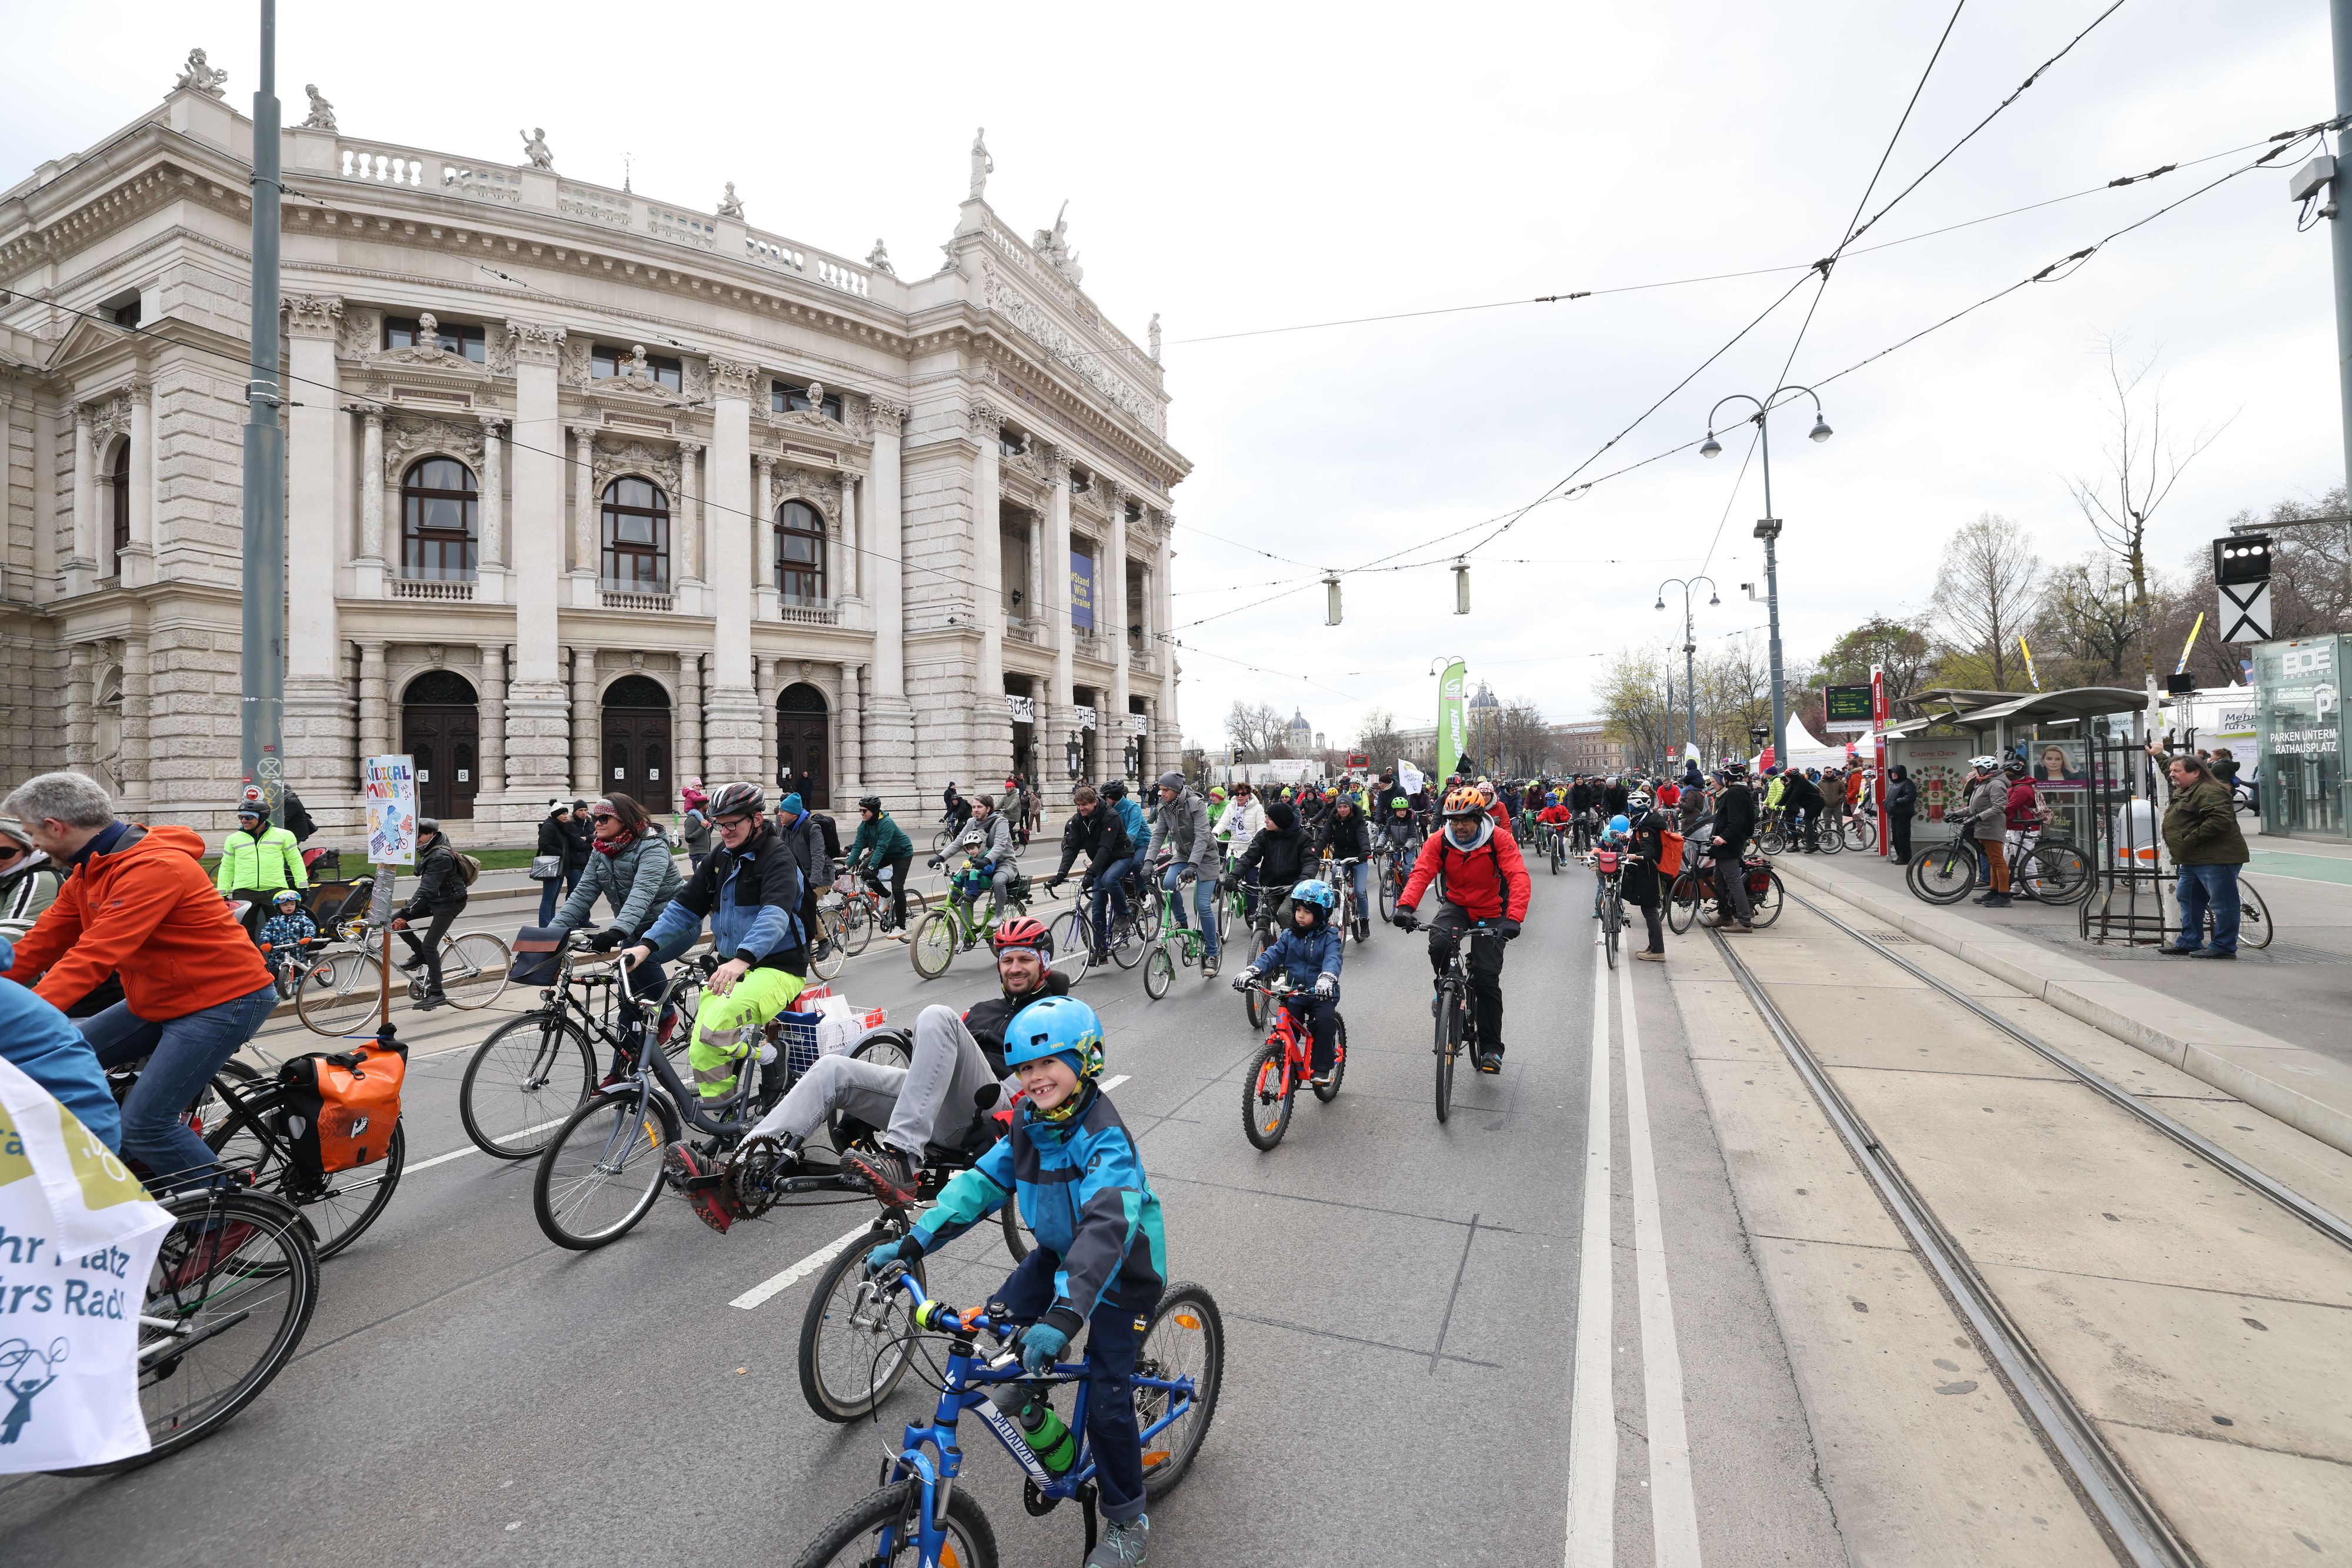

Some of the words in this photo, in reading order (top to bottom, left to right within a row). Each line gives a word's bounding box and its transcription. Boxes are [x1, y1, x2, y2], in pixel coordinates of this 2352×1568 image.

[1071, 571, 1090, 587] #Stand
[1074, 583, 1087, 597] With
[2283, 668, 2332, 681] PARKING
[2316, 693, 2333, 723] P
[2225, 713, 2257, 722] Mehr
[1450, 708, 1464, 758] GRÜNEN
[2270, 731, 2300, 743] PARKEN
[2302, 728, 2336, 741] UNTERM
[2276, 741, 2337, 754] RATHAUSPLATZ
[366, 782, 400, 800] MASS
[2053, 815, 2072, 827] Tchibo
[1050, 1041, 1065, 1049] uvex
[55, 1245, 131, 1279] atz
[989, 1410, 1037, 1466] SPECIALIZED
